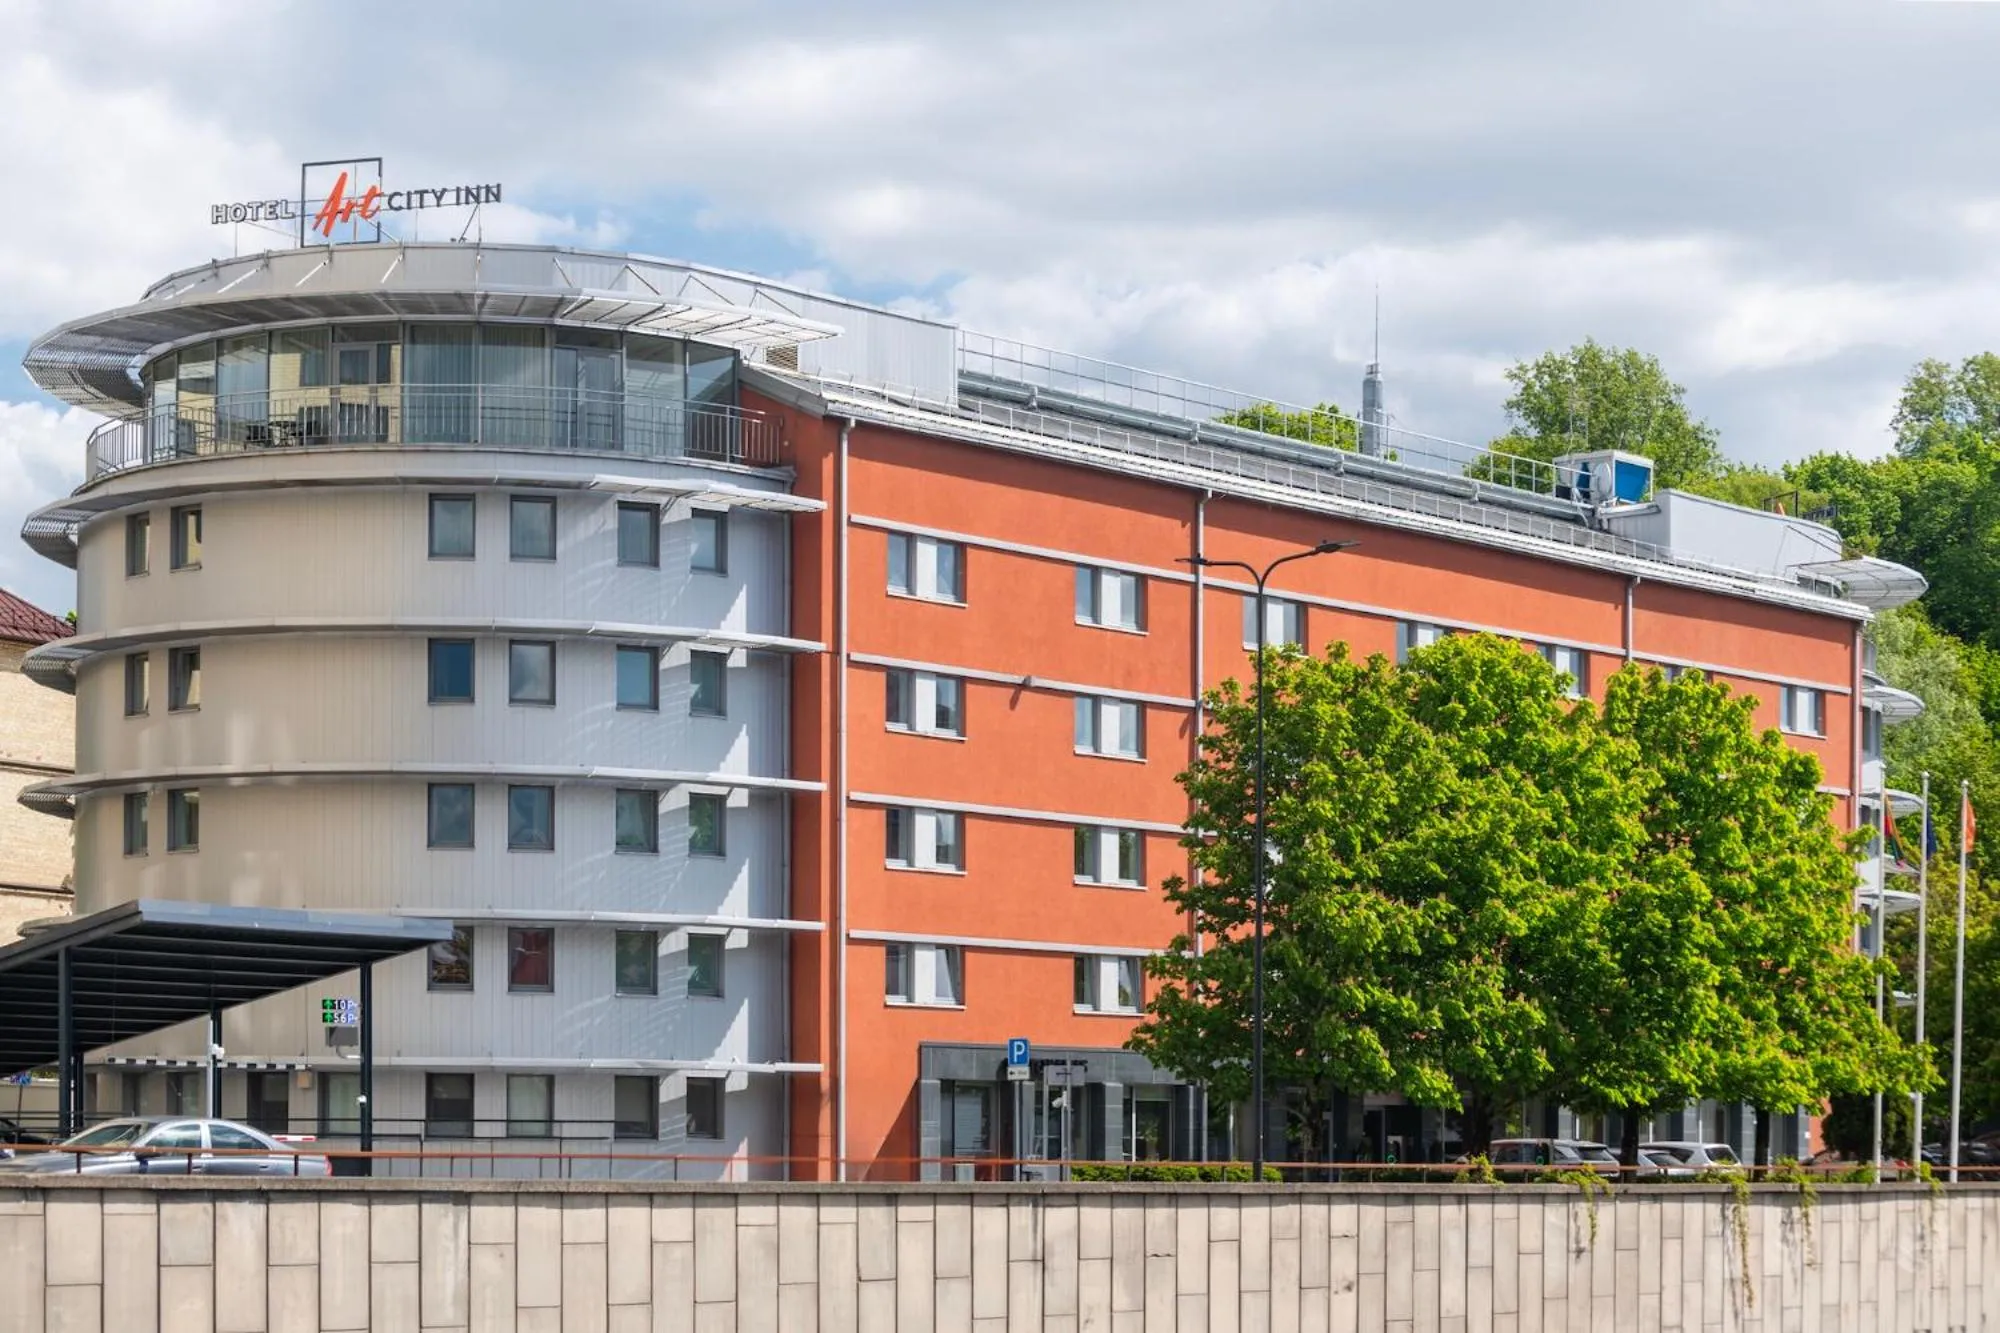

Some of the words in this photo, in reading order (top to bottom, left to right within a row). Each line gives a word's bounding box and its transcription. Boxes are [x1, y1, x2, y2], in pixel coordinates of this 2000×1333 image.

[211, 199, 296, 224] HOTEL
[312, 172, 384, 237] Art
[387, 187, 448, 211] CITY
[455, 183, 502, 205] INN
[1013, 1040, 1025, 1063] P
